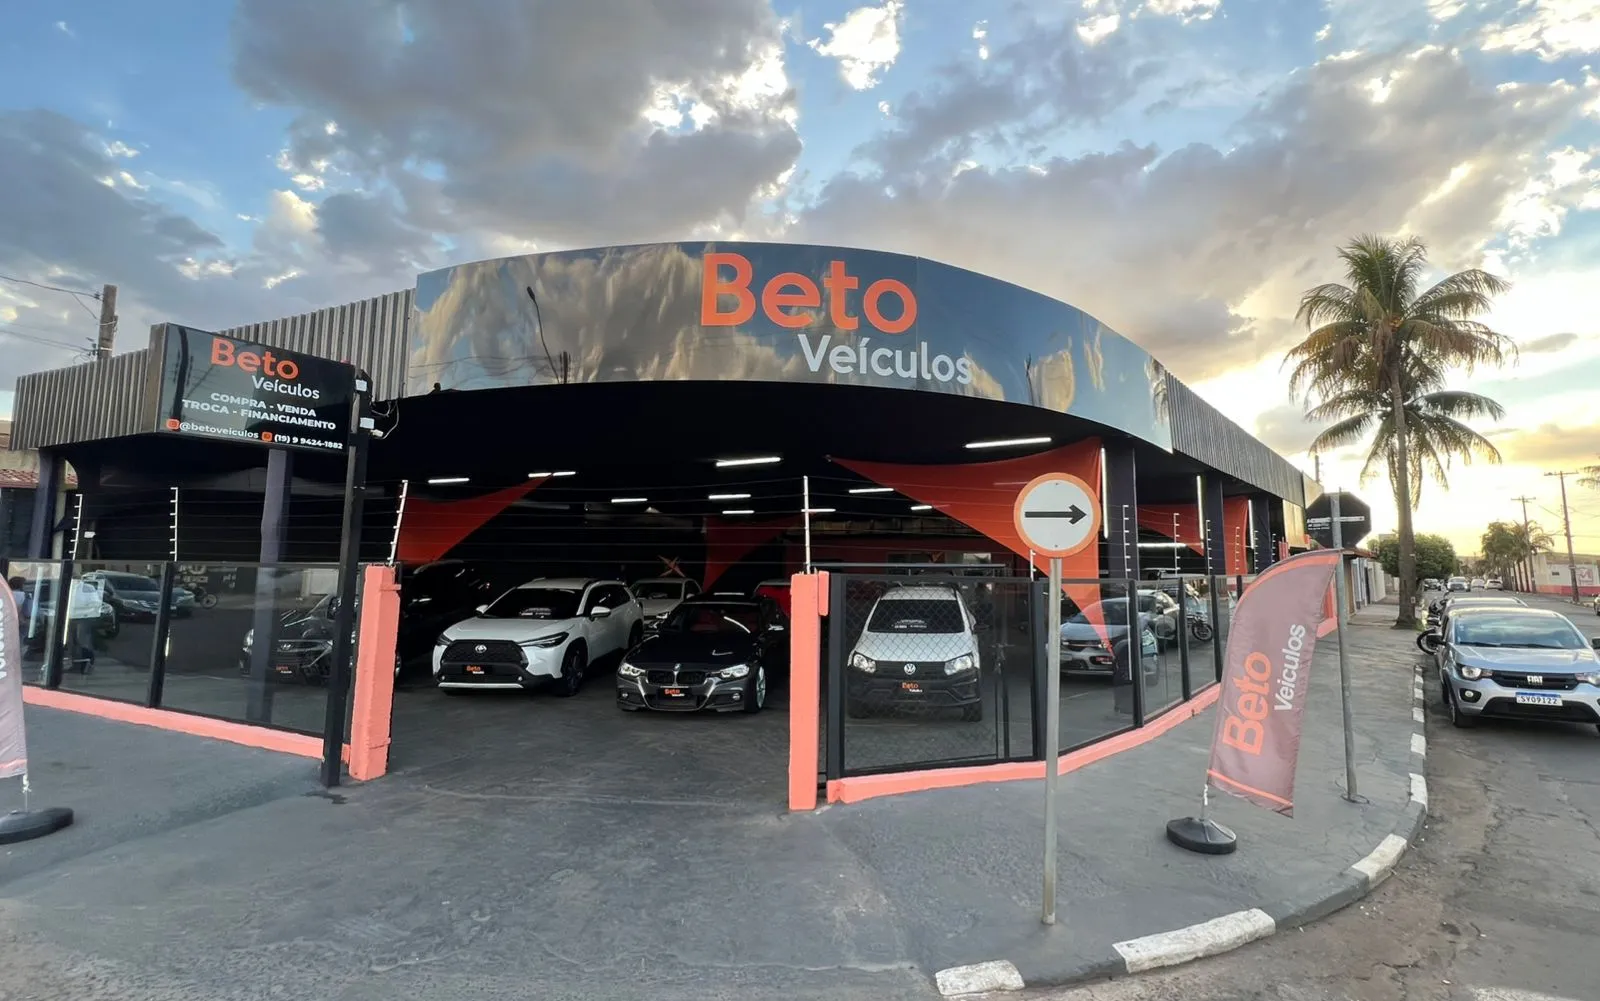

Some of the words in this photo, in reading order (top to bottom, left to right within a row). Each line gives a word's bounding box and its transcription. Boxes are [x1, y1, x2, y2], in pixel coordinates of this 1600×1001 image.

[701, 253, 917, 334] Beto
[210, 337, 299, 379] Beto
[797, 334, 973, 385] Veículos
[252, 375, 320, 399] Veículos
[182, 399, 230, 415] TROCA
[240, 409, 336, 430] FINANCIAMENTO
[210, 392, 266, 409] COMPRA
[277, 403, 317, 417] VENDA
[179, 421, 259, 439] @betoveiculos
[274, 433, 291, 444] (19)
[292, 436, 299, 444] 9
[1223, 652, 1271, 755] Beto
